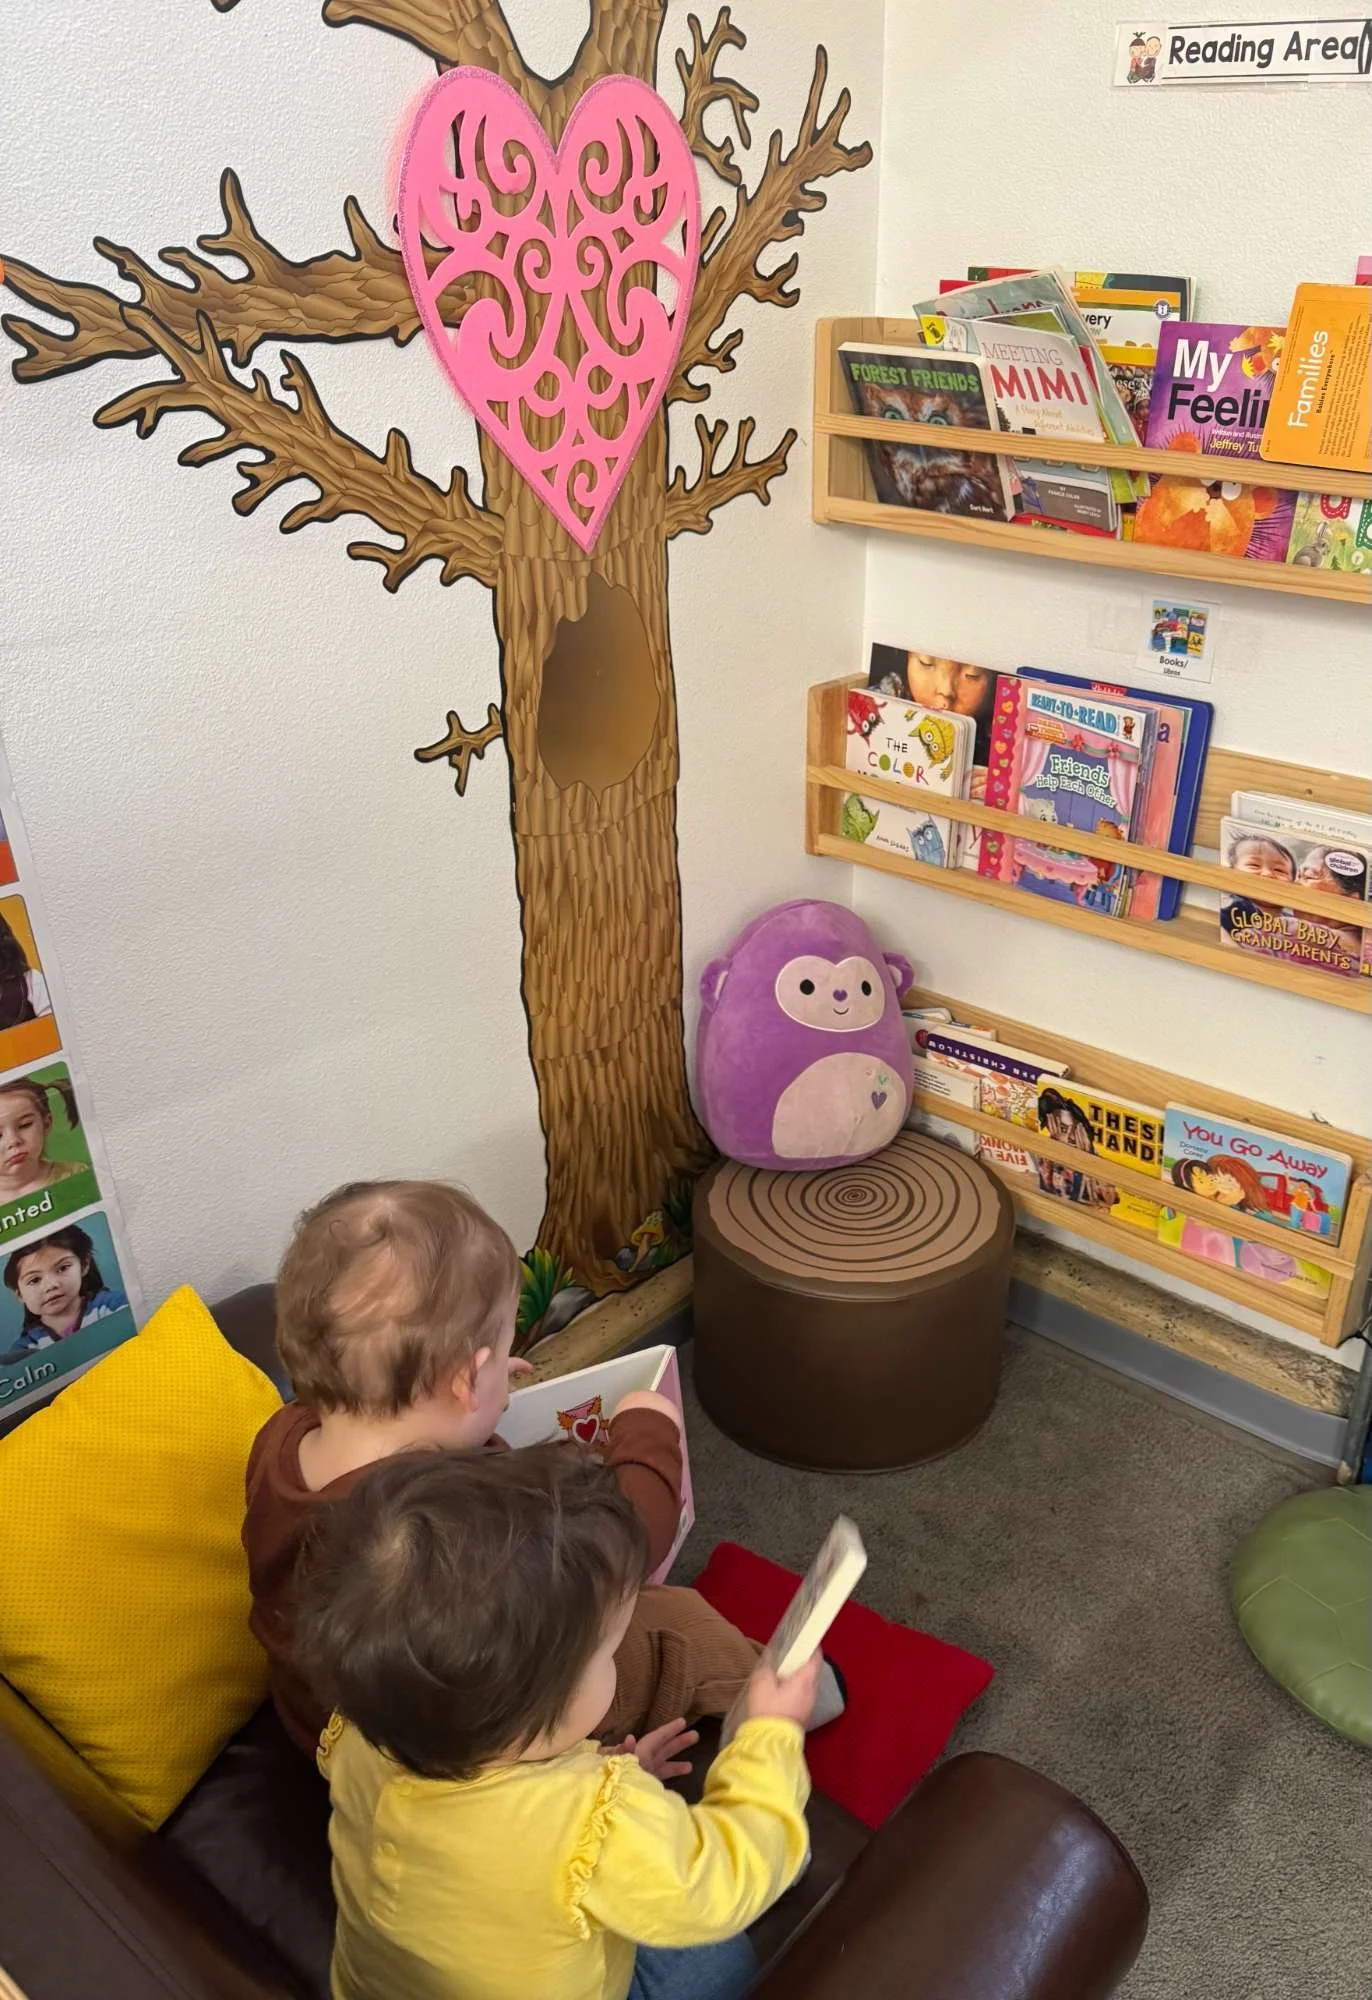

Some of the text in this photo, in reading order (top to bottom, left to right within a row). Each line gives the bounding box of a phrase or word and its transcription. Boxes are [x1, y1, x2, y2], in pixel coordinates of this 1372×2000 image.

[1168, 30, 1359, 68] Reading Area
[981, 342, 1064, 366] MEETING
[1172, 338, 1234, 393] My
[849, 363, 980, 393] FOREST FRIENDS
[990, 364, 1088, 406] MIMI
[1287, 330, 1329, 428] Families
[1316, 390, 1327, 414] Babies
[1210, 438, 1245, 453] Jeffrey
[1159, 656, 1189, 669] Books/
[886, 737, 909, 753] THE
[868, 751, 930, 786] COLOR
[1050, 754, 1109, 788] Friends
[1035, 774, 1116, 808] Help Each Other
[1328, 856, 1351, 868] global
[1329, 863, 1359, 874] children
[1230, 907, 1341, 949] GLOBAL BABY
[1230, 928, 1351, 970] GRANDPARENTS
[1183, 1120, 1224, 1148] You
[1267, 1150, 1328, 1179] Away
[0, 1191, 53, 1233] nted
[0, 1362, 56, 1398] Calm
